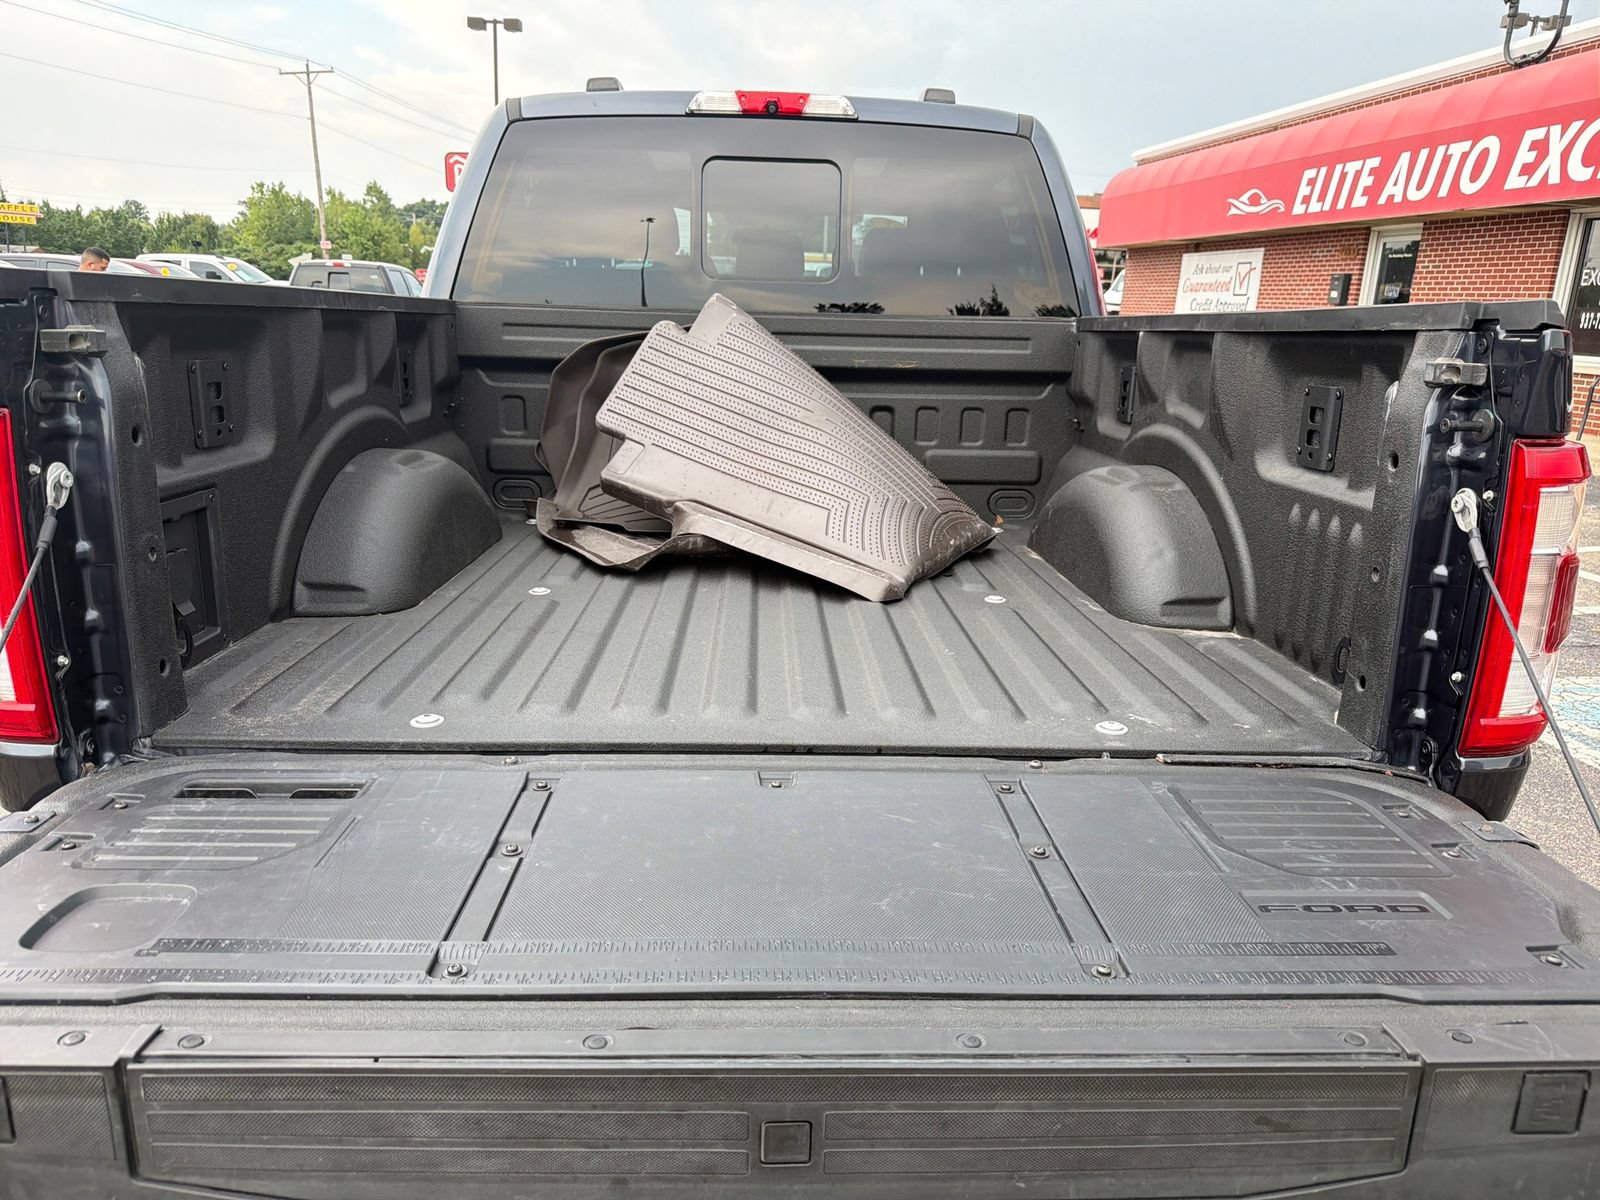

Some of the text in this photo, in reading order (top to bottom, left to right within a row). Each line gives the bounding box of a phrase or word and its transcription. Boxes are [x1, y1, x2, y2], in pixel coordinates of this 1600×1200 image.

[1291, 117, 1600, 215] ELITE AUTO EXC
[1182, 276, 1233, 294] Guaranteed
[1190, 296, 1250, 312] Credit Approval
[1580, 312, 1600, 329] 937-7
[1258, 904, 1432, 914] FORD
